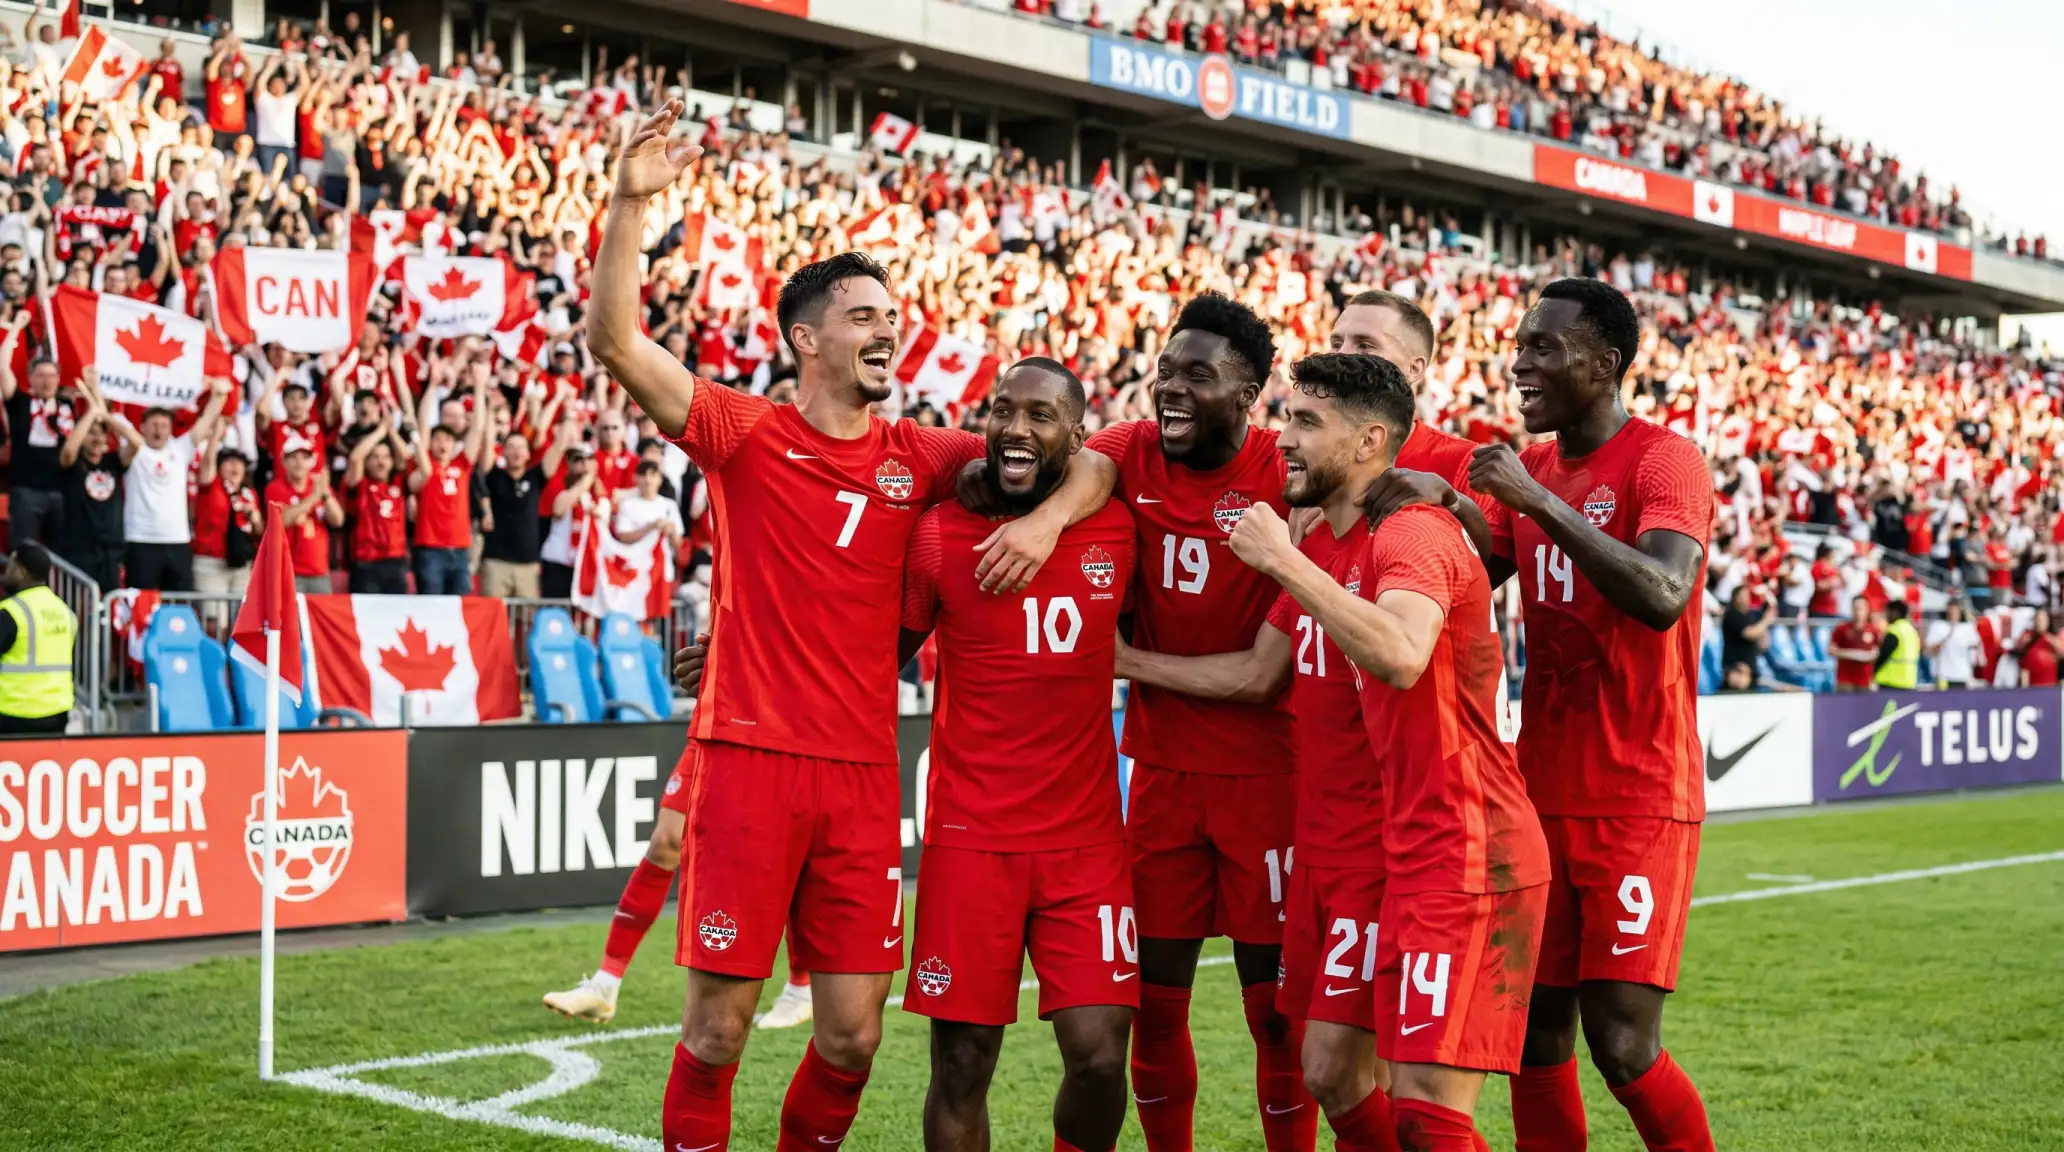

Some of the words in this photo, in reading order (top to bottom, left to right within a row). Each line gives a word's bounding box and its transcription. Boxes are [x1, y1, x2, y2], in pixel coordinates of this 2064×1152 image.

[1110, 45, 1193, 98] BMO
[1241, 76, 1339, 131] FIELD
[256, 275, 340, 318] CAN
[99, 373, 149, 394] MAPLE
[836, 490, 868, 548] 7
[1214, 509, 1245, 518] CANA
[1162, 533, 1210, 594] 19
[1535, 544, 1574, 602] 14
[1023, 596, 1083, 653] 10
[1296, 614, 1326, 678] 21
[1914, 705, 2040, 767] TELUS
[0, 755, 207, 842] SOCCER
[480, 756, 658, 877] NIKE
[887, 867, 903, 927] 7
[1616, 874, 1655, 936] 9
[1098, 904, 1139, 964] 10
[1324, 917, 1379, 982] 21
[917, 971, 951, 983] CANADA
[1399, 952, 1451, 1017] 14
